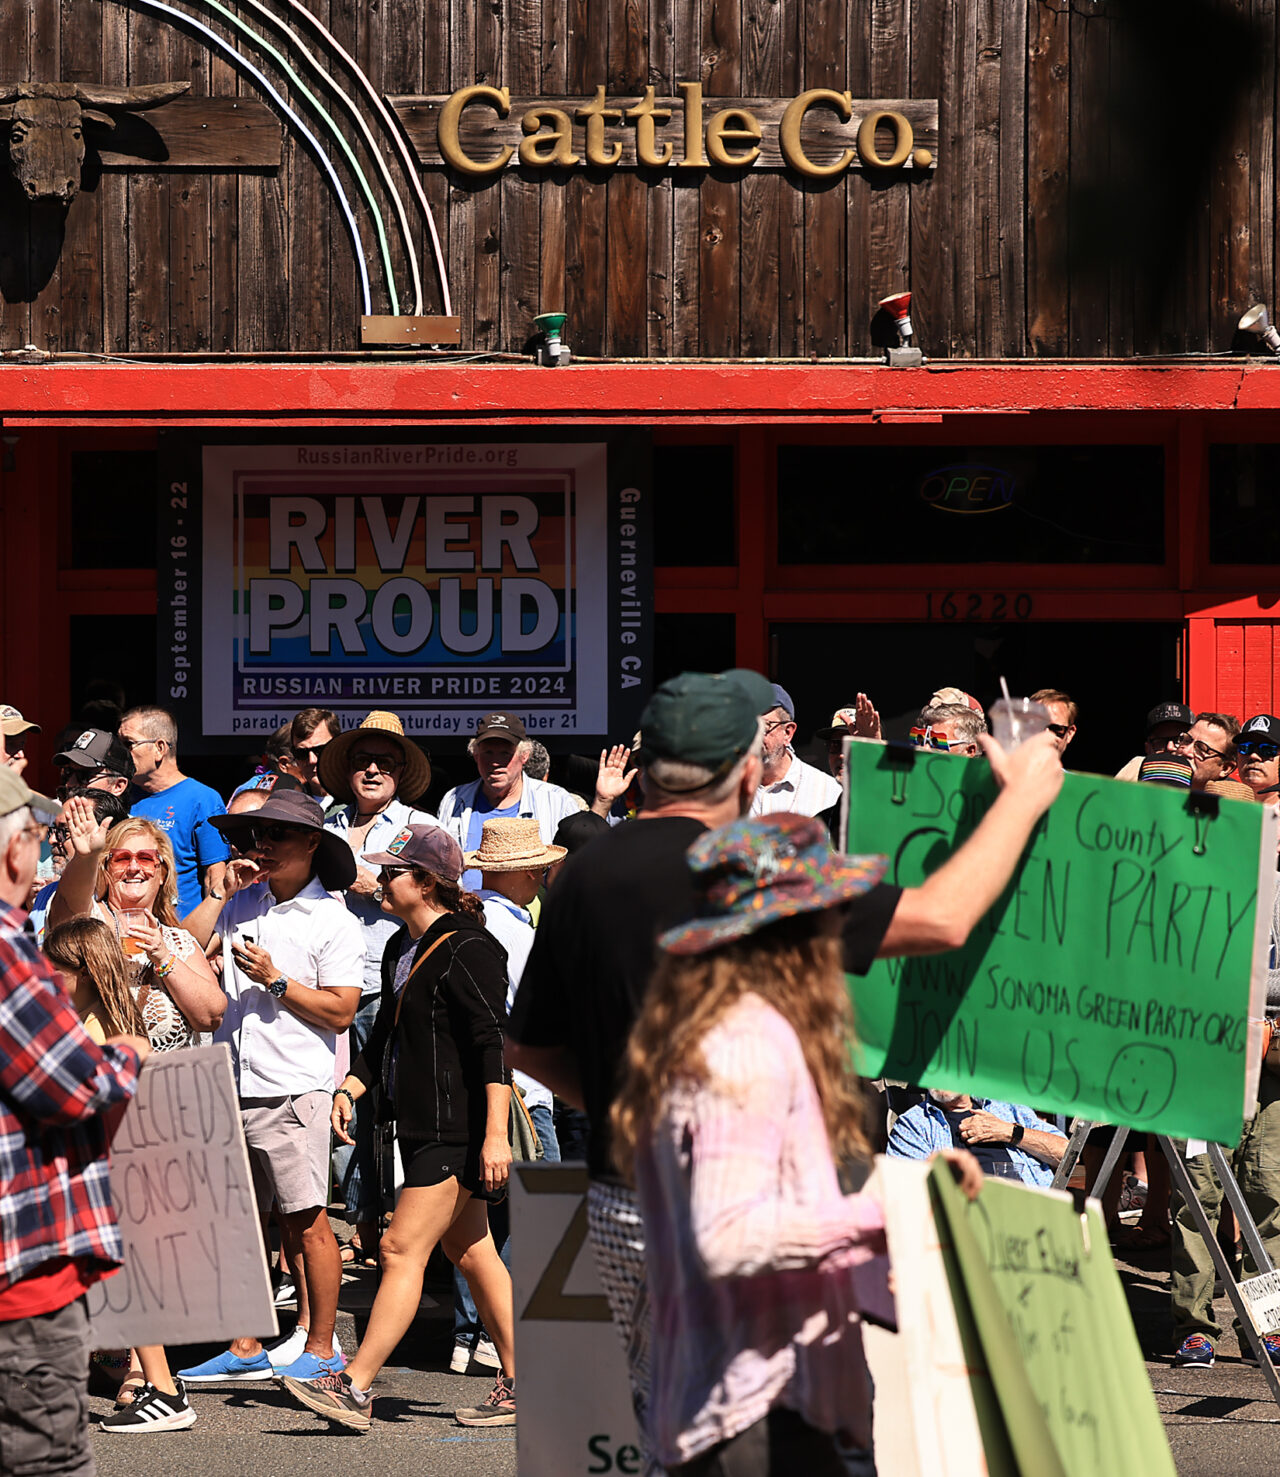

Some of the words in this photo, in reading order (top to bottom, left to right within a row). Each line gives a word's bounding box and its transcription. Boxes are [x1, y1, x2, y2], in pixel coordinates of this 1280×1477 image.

[438, 82, 762, 176] Cattle
[780, 88, 932, 178] Co.
[297, 447, 518, 466] RussianRiverPride.org
[921, 476, 1016, 501] OPEN
[170, 482, 187, 510] 22
[170, 535, 187, 559] 16
[269, 495, 539, 573] RIVER
[621, 487, 642, 645] Guerneville
[170, 569, 191, 699] September
[249, 577, 560, 656] PROUD
[926, 592, 1033, 620] 16220
[243, 678, 343, 695] RUSSIAN
[352, 678, 420, 695] RIVER
[432, 677, 501, 694] PRIDE
[510, 677, 566, 694] 2024
[621, 655, 642, 689] CA
[232, 714, 288, 732] parade
[400, 714, 461, 732] aturday
[561, 713, 577, 729] 21
[1076, 790, 1183, 865] County
[1106, 858, 1257, 979] PARTY
[897, 1000, 980, 1078] JOIN
[1023, 1030, 1080, 1103] US
[89, 1222, 223, 1321] UNTY
